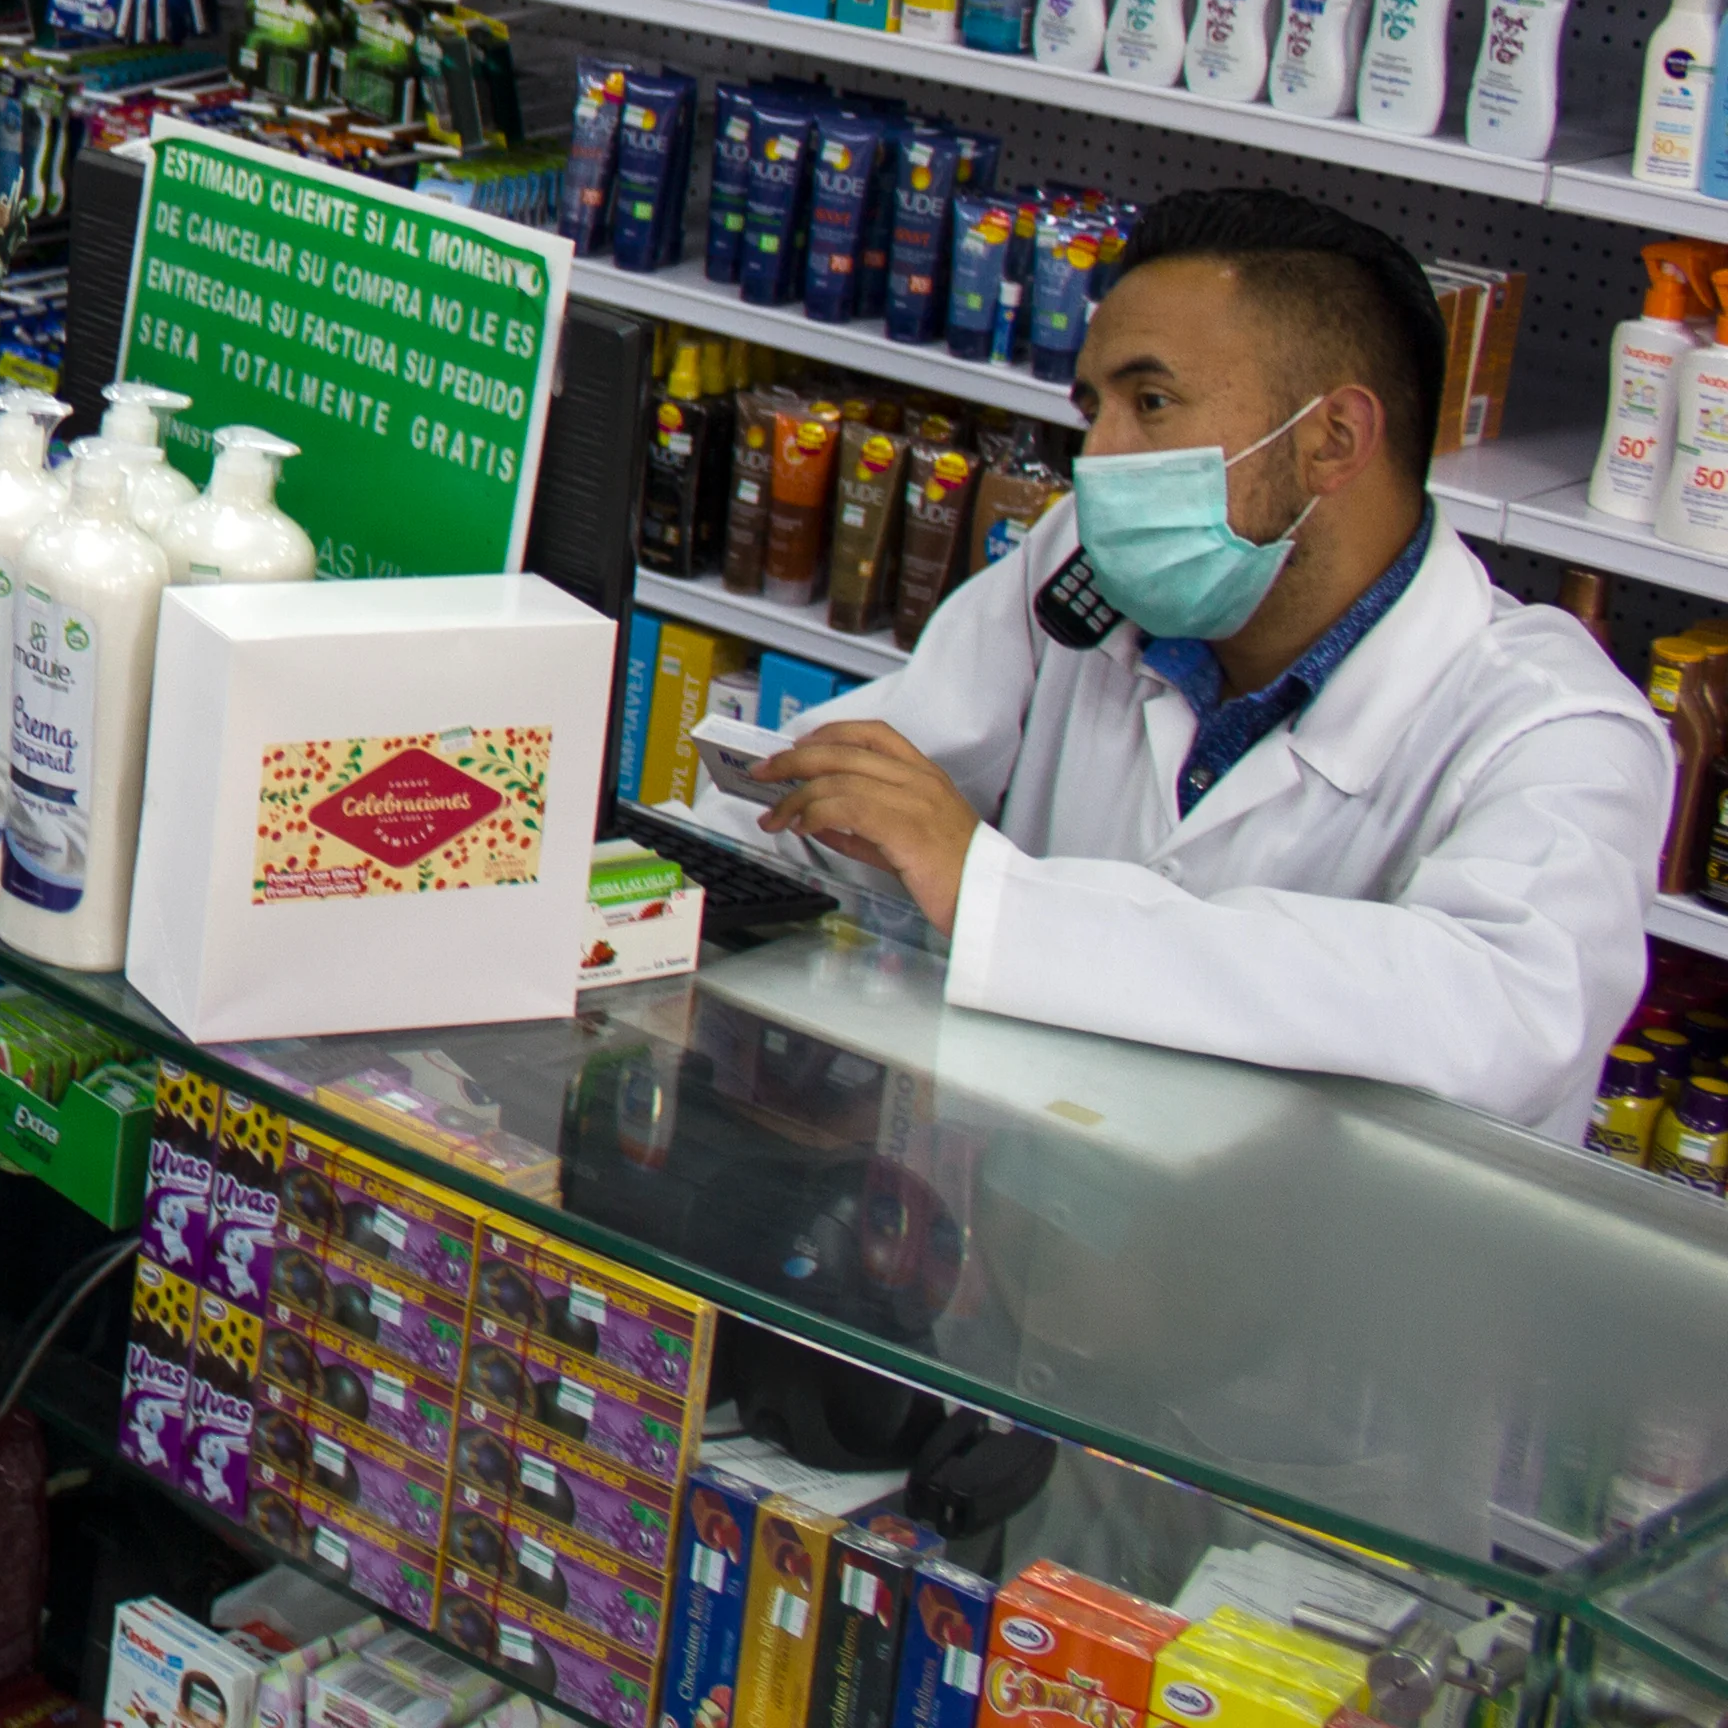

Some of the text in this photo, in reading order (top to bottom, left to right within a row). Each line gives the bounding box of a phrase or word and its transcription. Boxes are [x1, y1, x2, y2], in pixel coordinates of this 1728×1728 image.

[162, 144, 543, 298] ESTIMADO CLIENTE SI AL MOMENTO
[155, 201, 537, 361] DE CANCELAR SU COMPRA NO LE ES
[147, 257, 526, 423] ENTREGADA SU FACTURA SU PEDIDO
[138, 313, 201, 365] SERA
[220, 342, 391, 437] TOTALMENTE
[411, 415, 517, 485] GRATIS
[13, 693, 78, 750] Crema
[341, 791, 473, 818] Celebraciones
[372, 822, 437, 848] FAMILIA
[14, 1103, 60, 1146] Extra
[149, 1138, 212, 1182] Uvas
[216, 1171, 279, 1220] Uvas
[126, 1341, 188, 1390] Uvas
[190, 1377, 254, 1427] Uvas
[117, 1634, 181, 1688] CHOCOLATE
[677, 1582, 708, 1702] Chocolates Relle
[747, 1651, 773, 1728] Chocolates
[828, 1614, 858, 1728] colates Rellenos
[911, 1657, 937, 1722] Rellenos
